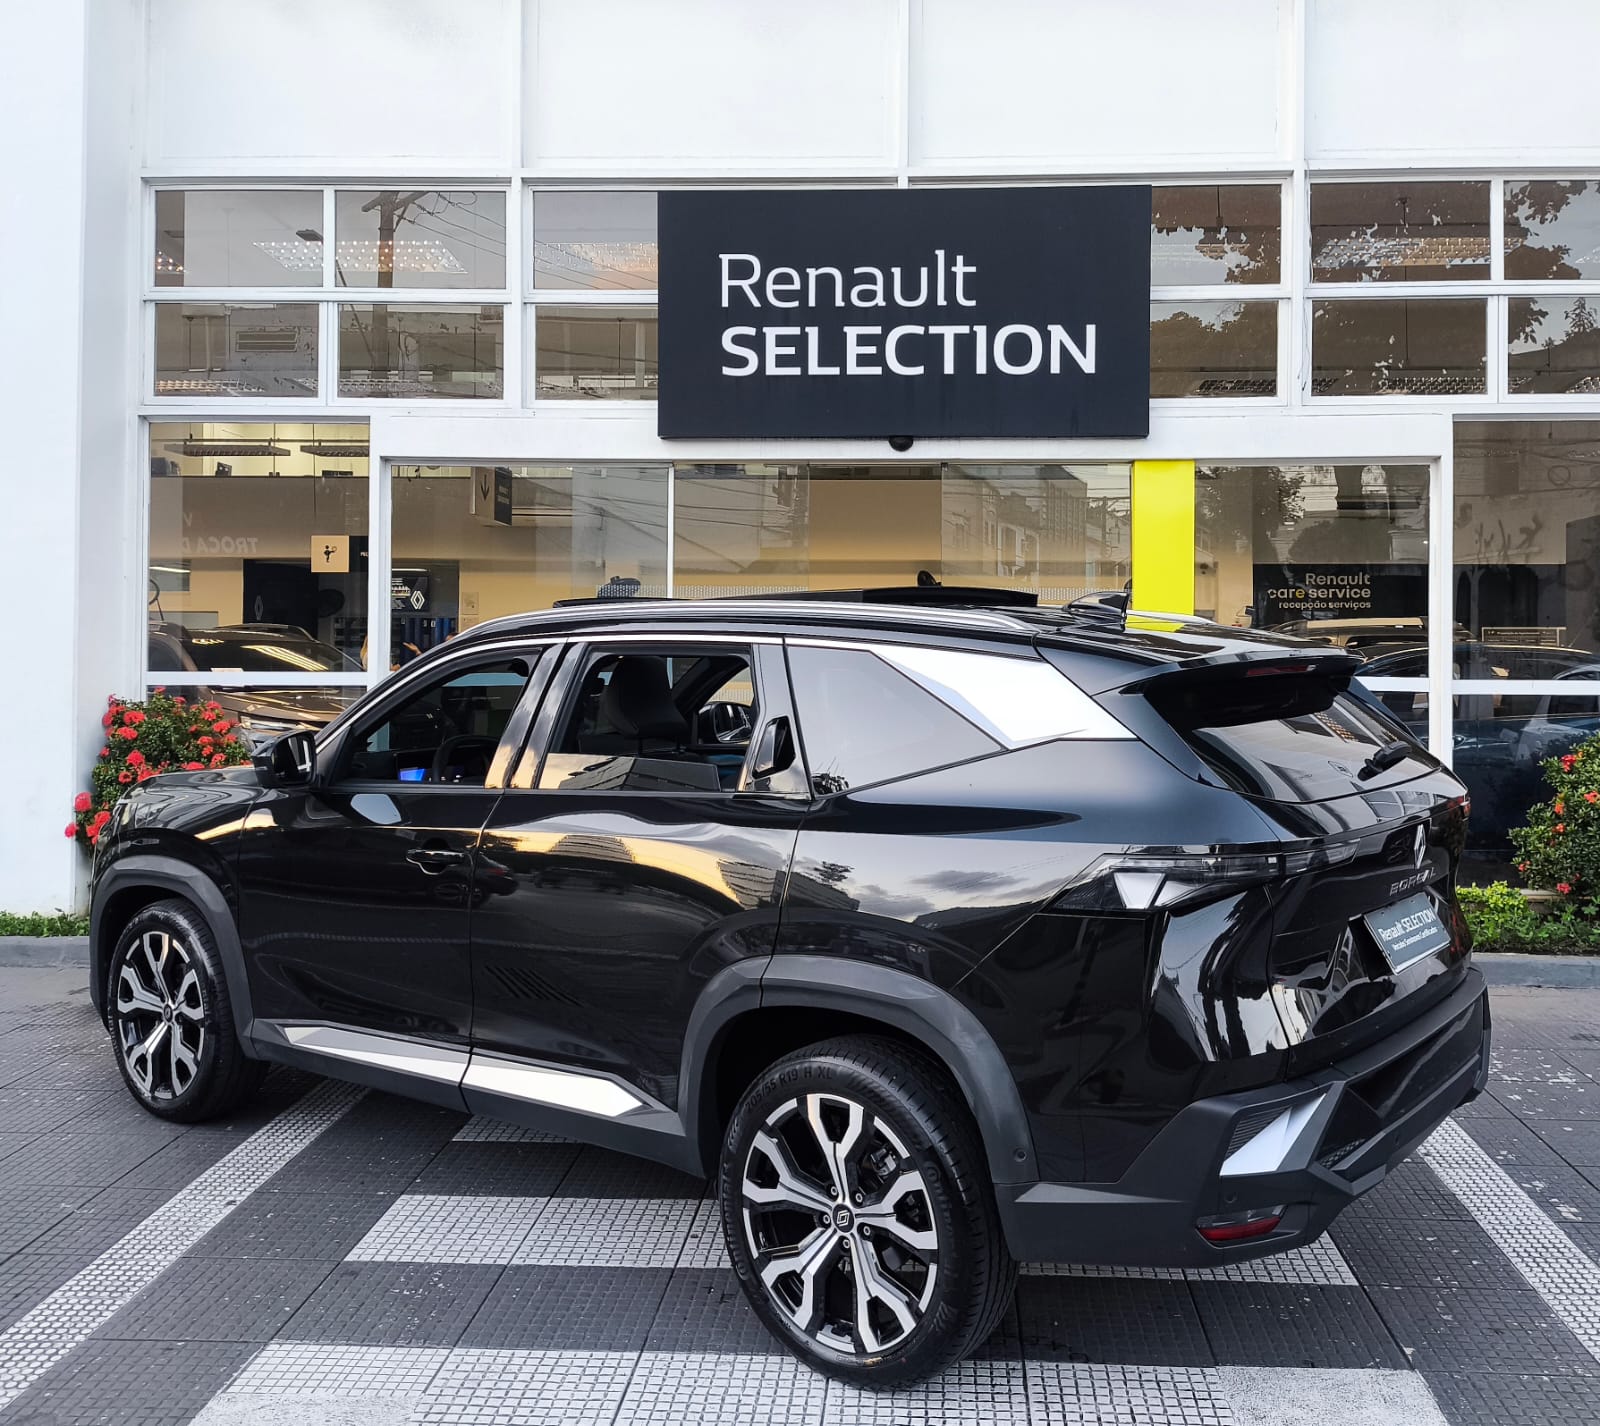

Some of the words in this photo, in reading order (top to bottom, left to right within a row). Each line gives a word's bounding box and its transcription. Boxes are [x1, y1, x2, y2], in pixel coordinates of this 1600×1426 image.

[719, 249, 977, 308] Renault
[721, 324, 1097, 377] SELECTION
[1305, 571, 1371, 585] Renault
[1267, 588, 1306, 599] care
[1308, 585, 1371, 599] service
[1328, 601, 1371, 611] serviços
[1401, 908, 1437, 933] SELECTION
[779, 1068, 799, 1088] R19
[803, 1066, 813, 1079] H
[818, 1066, 833, 1080] XL
